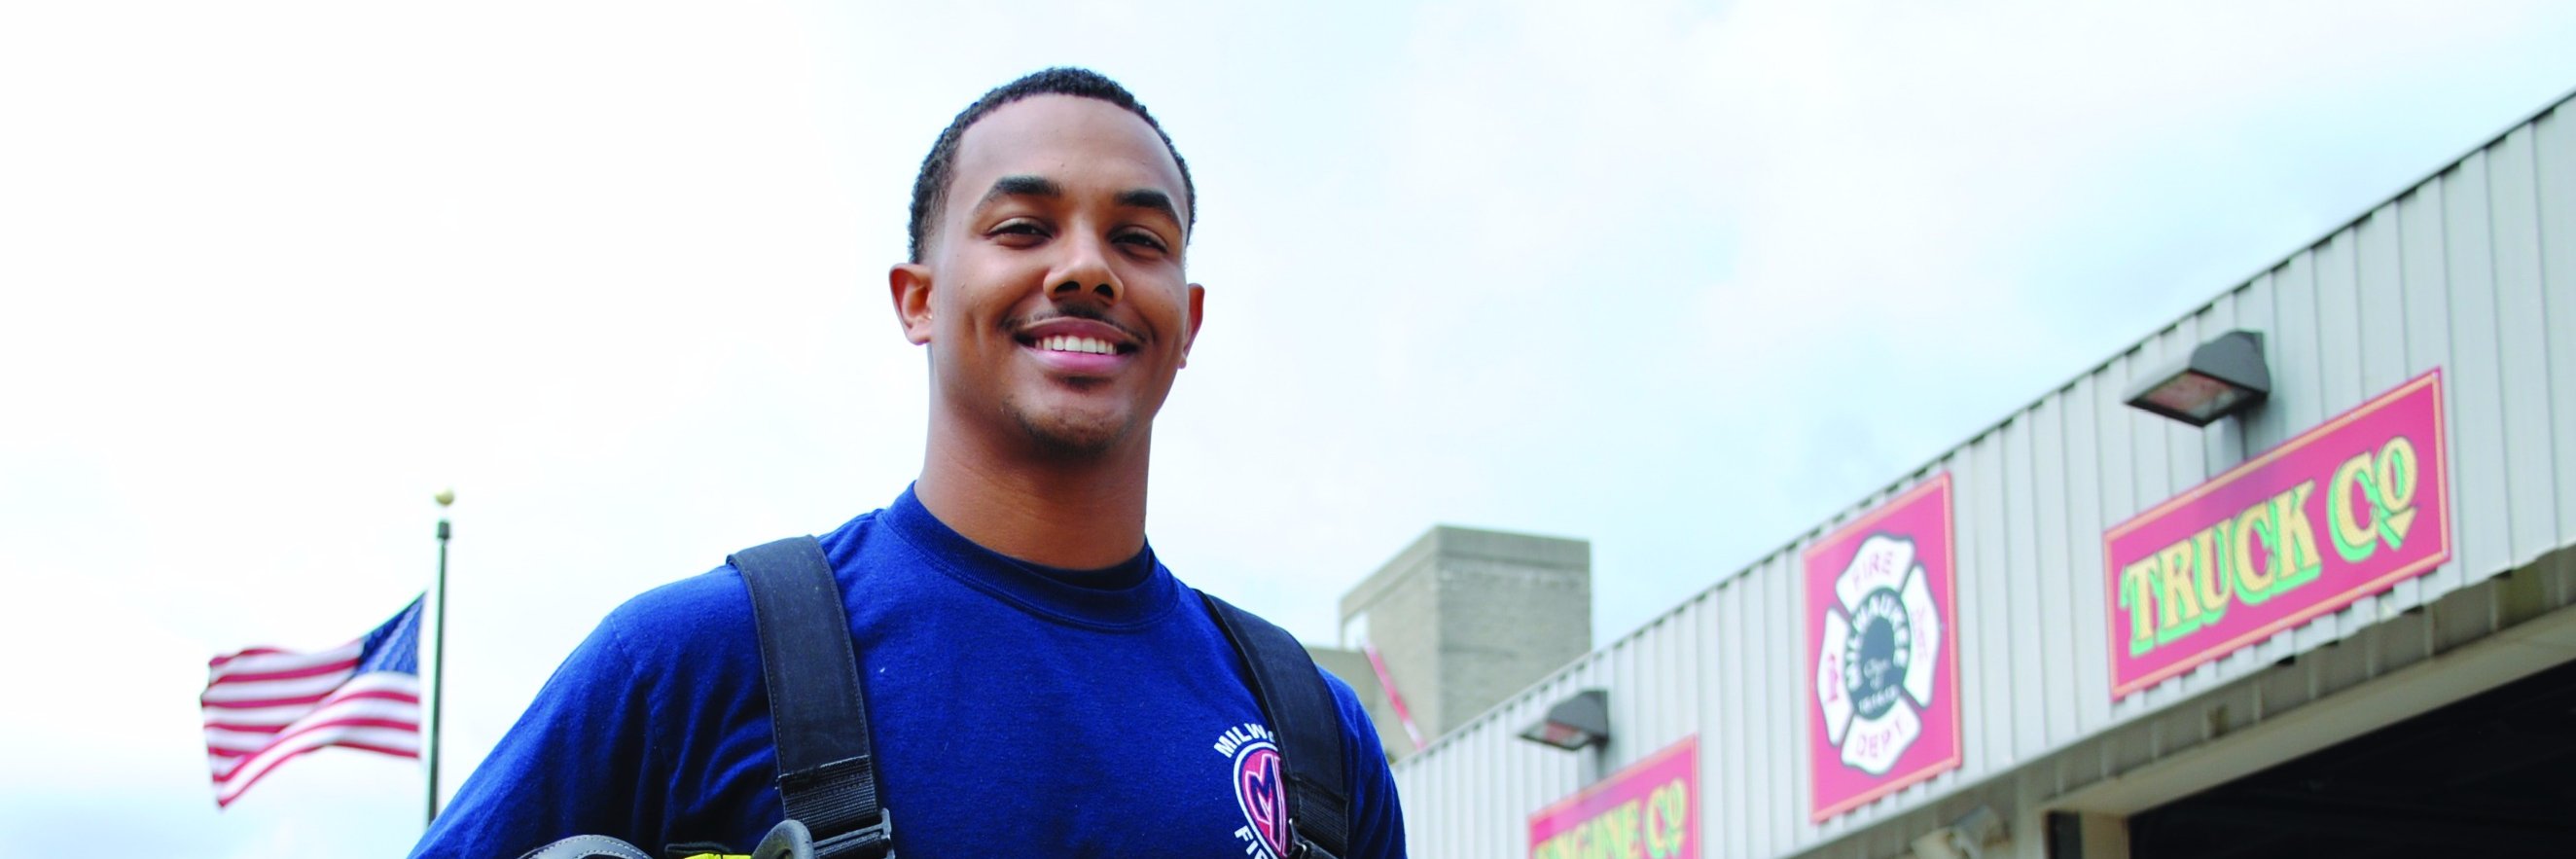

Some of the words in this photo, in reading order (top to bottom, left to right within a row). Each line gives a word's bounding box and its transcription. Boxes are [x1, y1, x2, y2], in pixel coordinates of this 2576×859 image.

[1851, 551, 1894, 591] FIRE
[2122, 480, 2322, 656] TRUCK
[1845, 594, 1910, 691] MILWAUKEE
[1857, 715, 1904, 759] DEPT
[1533, 798, 1641, 859] INE
